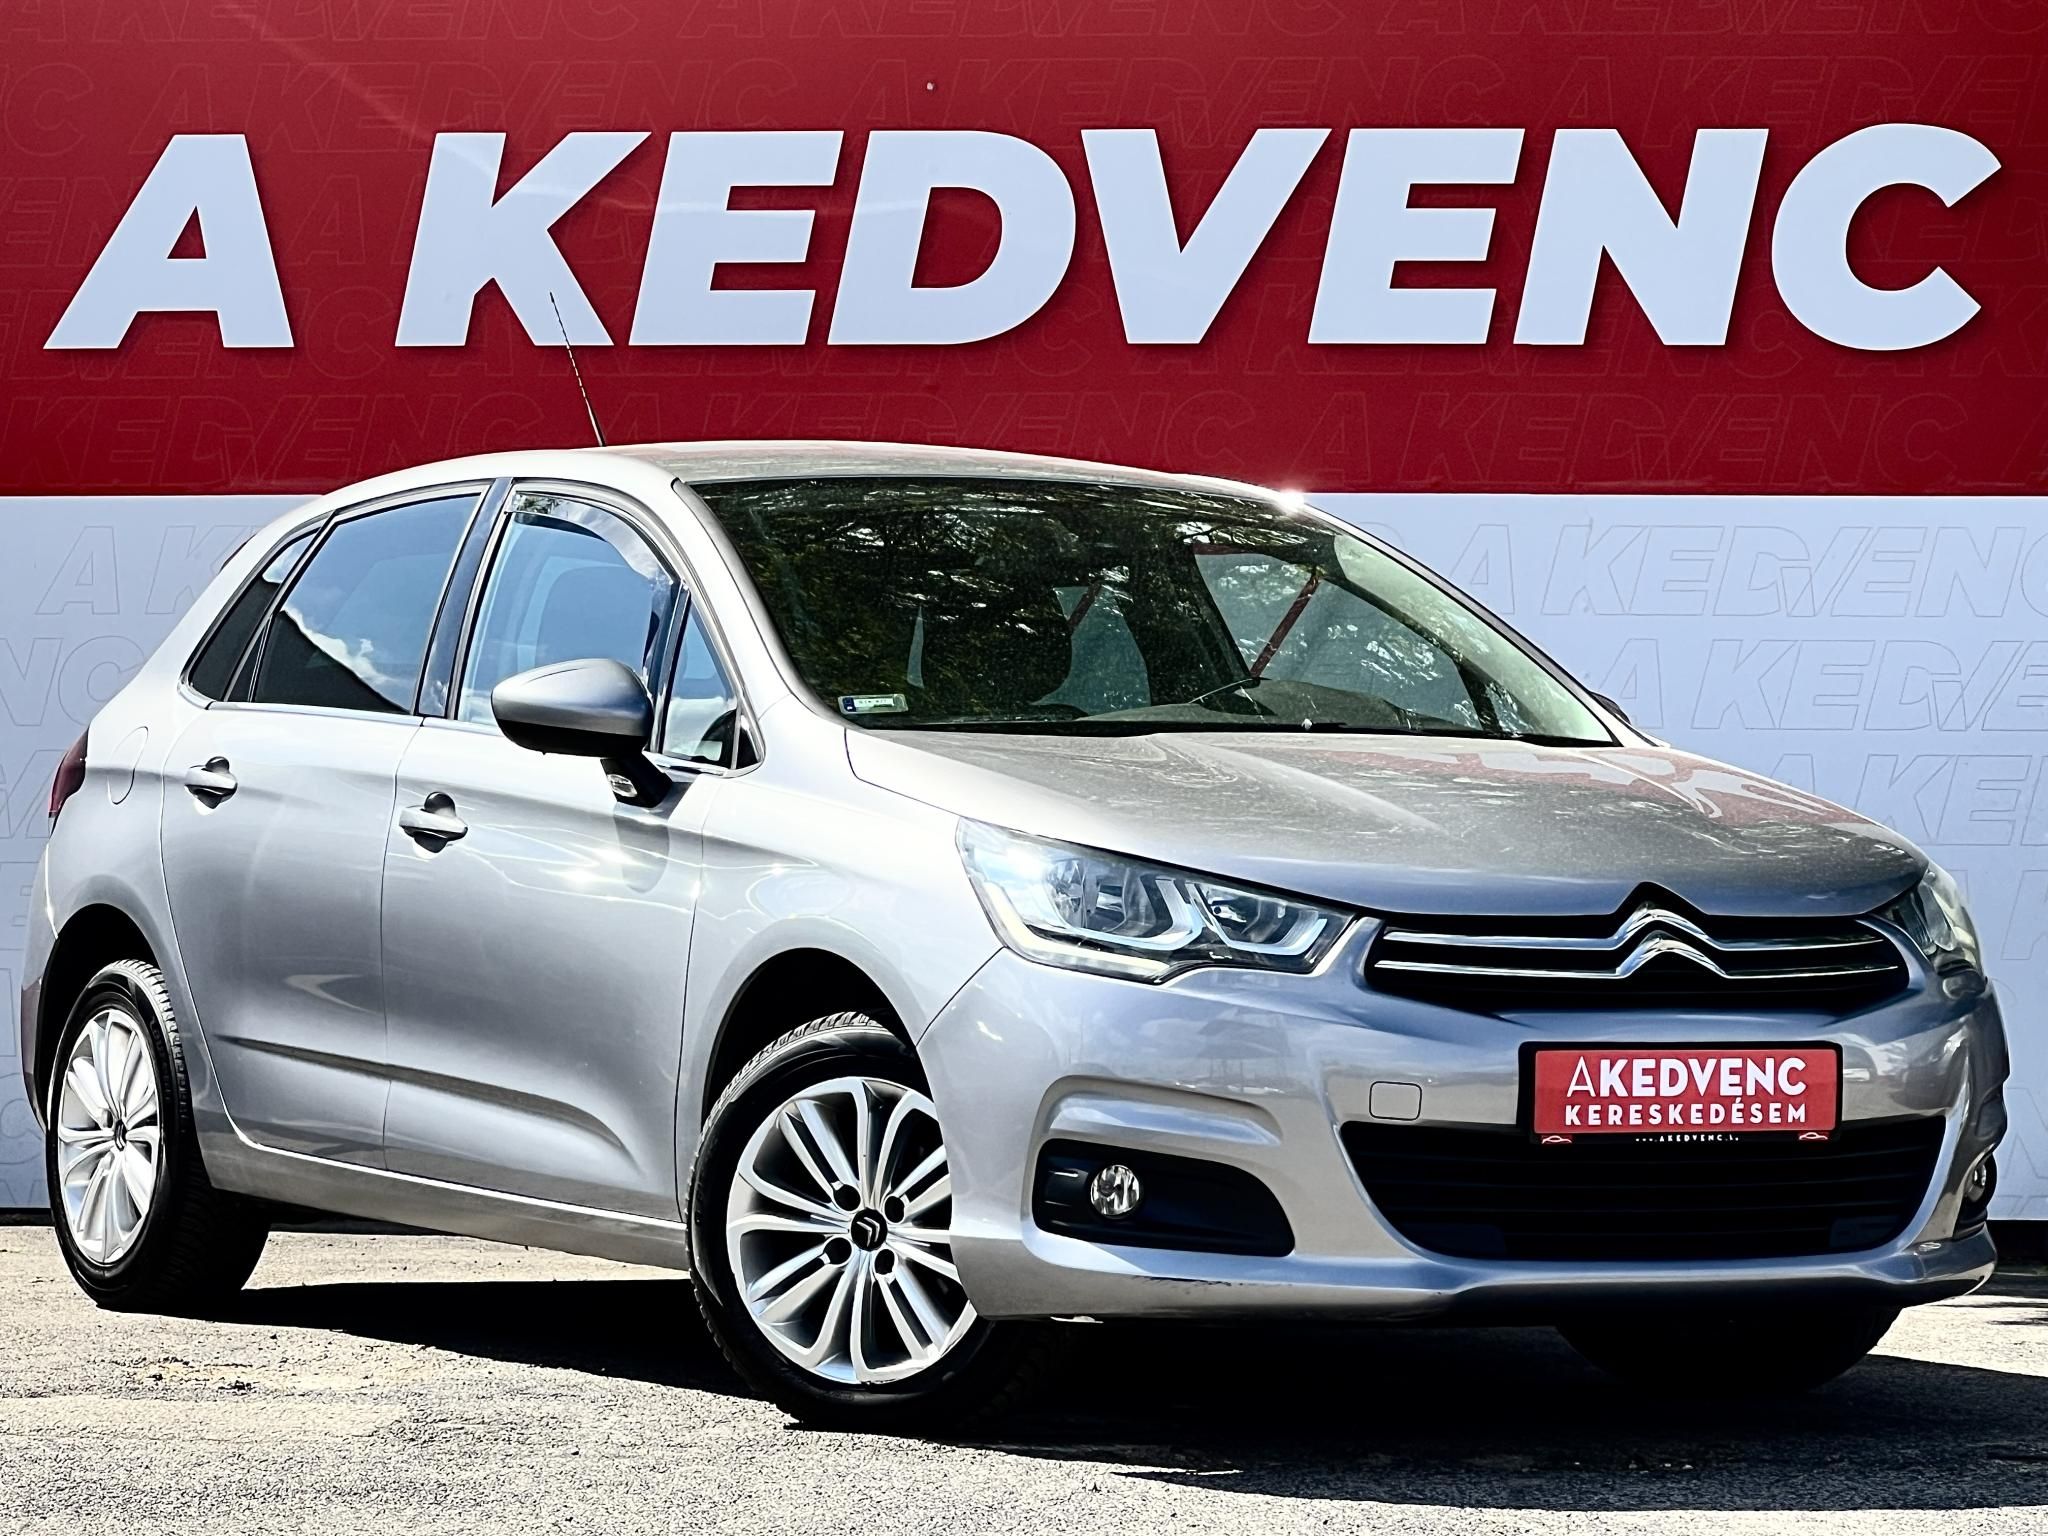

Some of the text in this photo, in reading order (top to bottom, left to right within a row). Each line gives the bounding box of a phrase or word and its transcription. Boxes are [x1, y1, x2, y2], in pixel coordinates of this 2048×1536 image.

[42, 133, 295, 350] A
[394, 122, 2002, 352] KEDVENC
[1565, 1097, 1806, 1126] KERESKEDÉSEM
